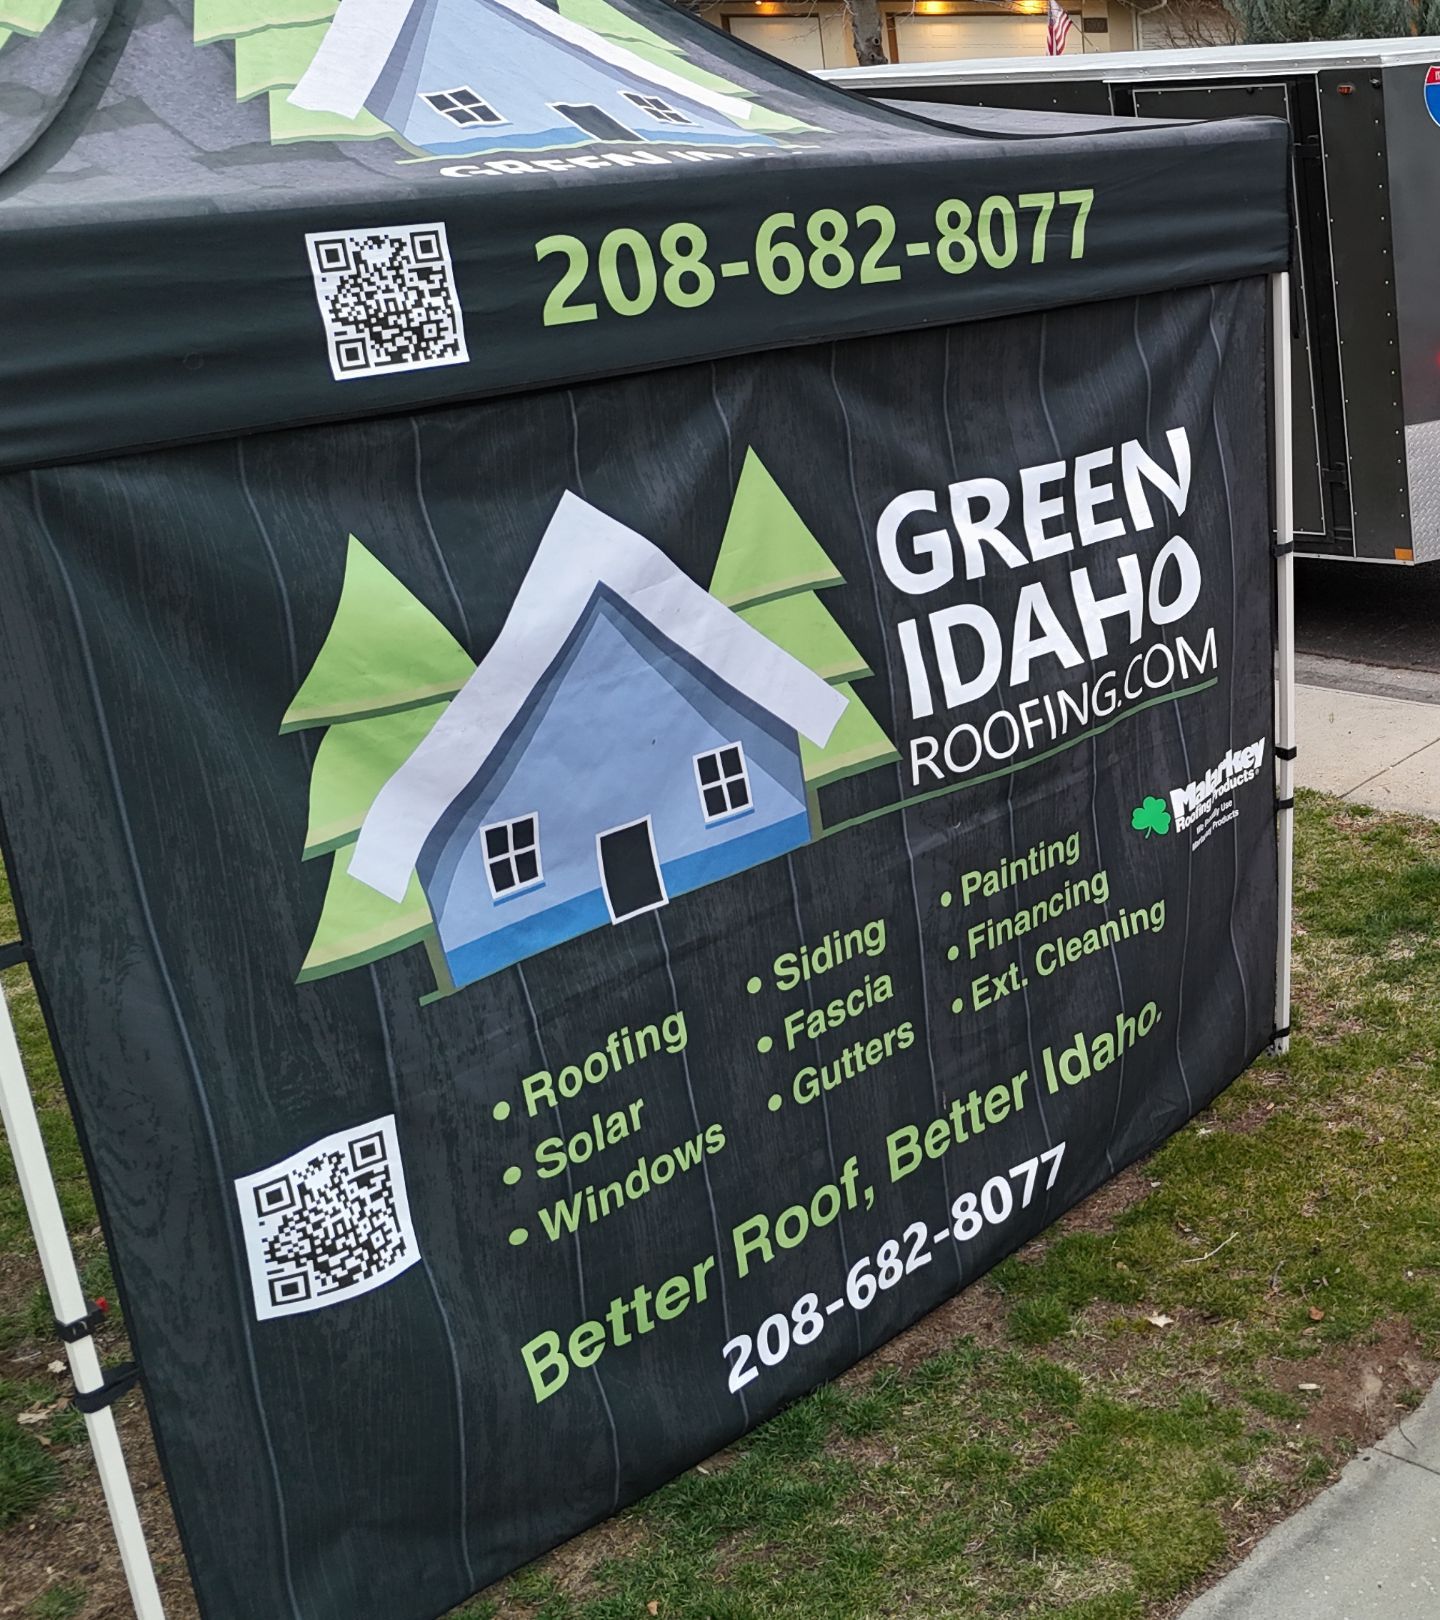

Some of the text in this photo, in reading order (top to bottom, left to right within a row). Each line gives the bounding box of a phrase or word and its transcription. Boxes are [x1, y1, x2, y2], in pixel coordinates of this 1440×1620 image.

[534, 188, 1095, 327] 208-682-8077
[876, 427, 1192, 595] GREEN
[897, 535, 1201, 720] IDAHO
[910, 627, 1218, 786] ROOFING.COM
[1169, 736, 1265, 819] Malarkey
[1175, 798, 1212, 833] Roofing
[1212, 809, 1239, 830] Products
[1220, 799, 1233, 812] Use
[962, 831, 1081, 907] Painting
[966, 868, 1110, 960] Financing
[773, 917, 887, 990] Siding
[972, 900, 1167, 1013] Ext. Cleaning
[784, 971, 894, 1051] Fascia
[522, 1009, 689, 1117] Roofing
[794, 1016, 916, 1104] Gutters
[534, 1097, 646, 1179] Solar
[538, 1123, 726, 1241] Windows
[520, 1001, 1164, 1404] Better Roof, Better Idaho.
[723, 1142, 1066, 1395] 208-682-8077
